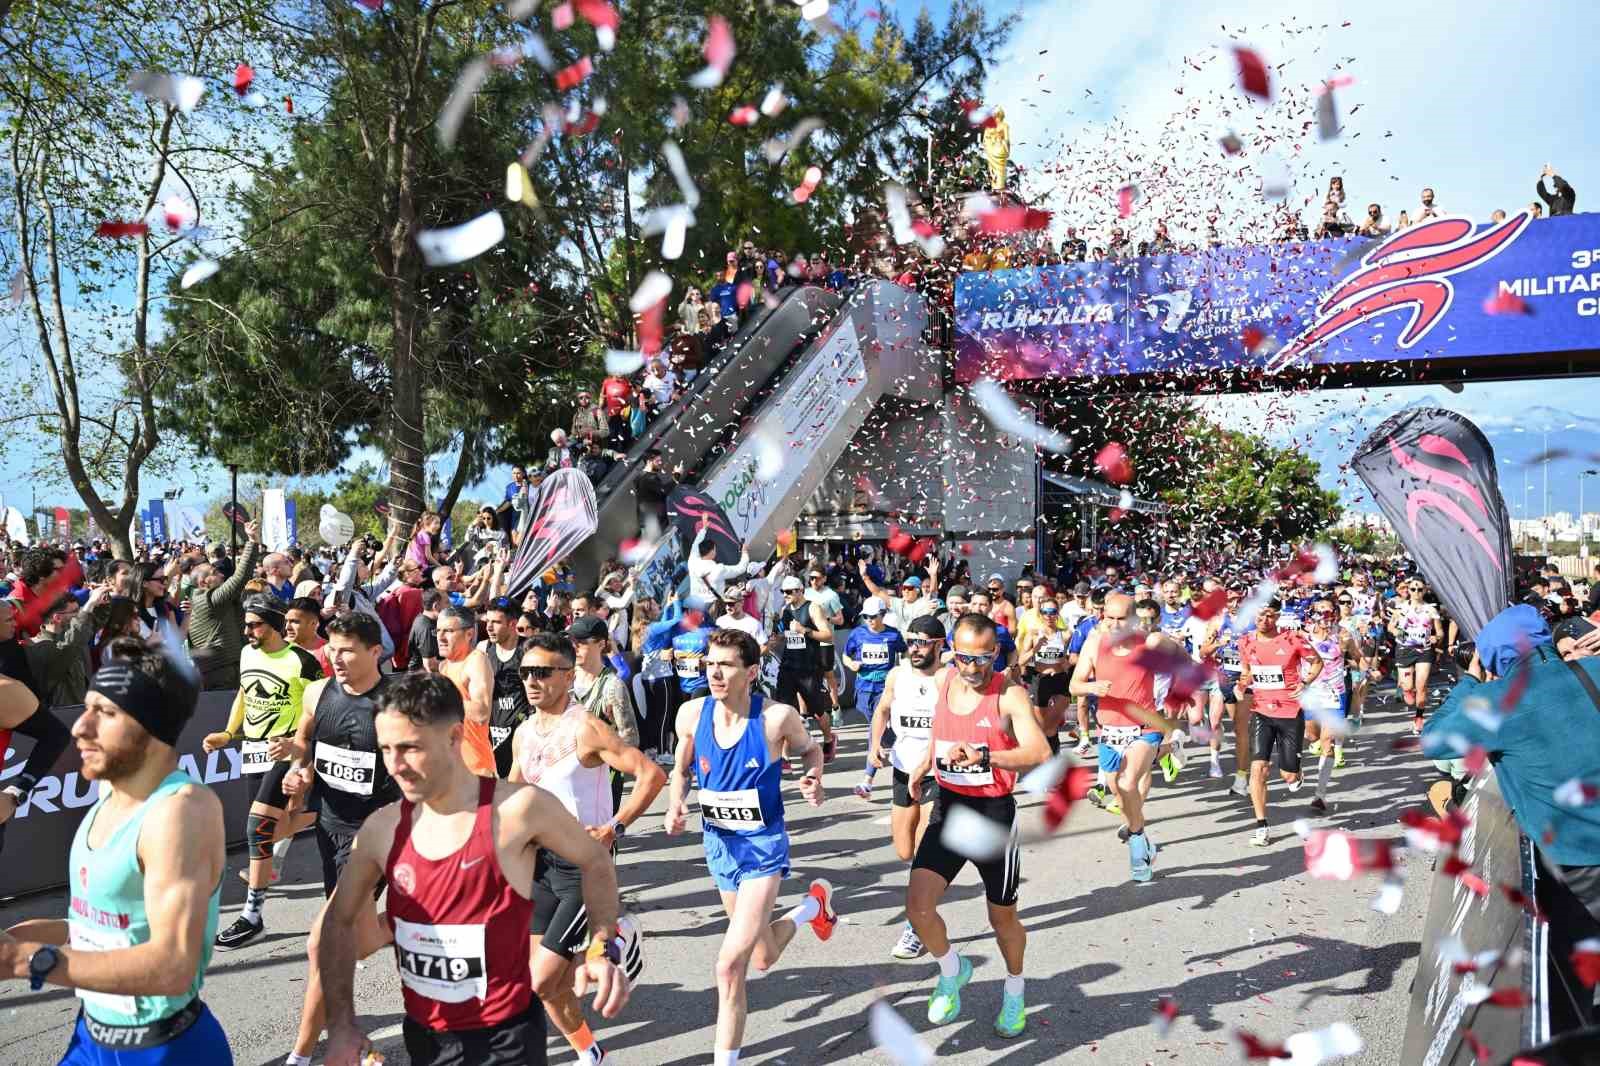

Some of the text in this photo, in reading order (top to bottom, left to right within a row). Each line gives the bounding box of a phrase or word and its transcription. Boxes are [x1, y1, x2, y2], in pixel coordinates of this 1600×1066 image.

[323, 761, 365, 784] 1086
[709, 806, 754, 821] 1519
[405, 953, 470, 982] 1719
